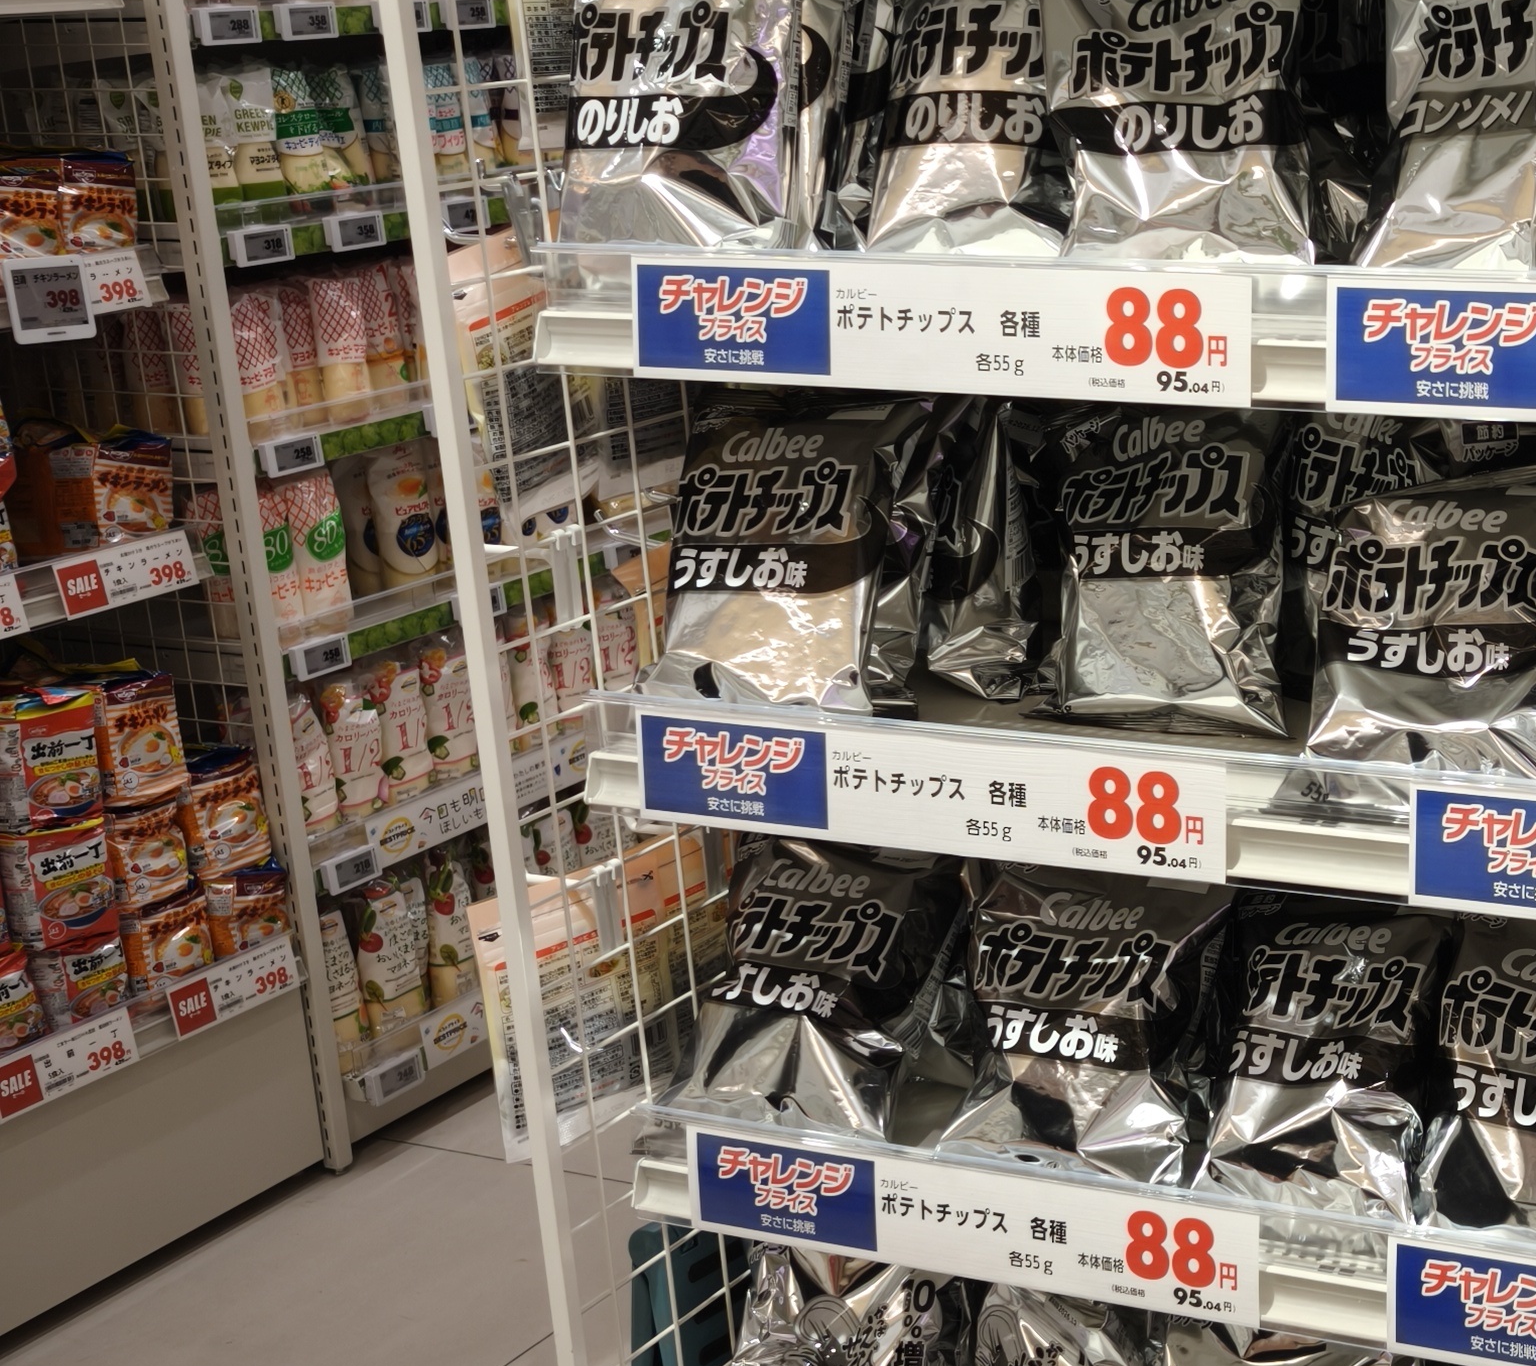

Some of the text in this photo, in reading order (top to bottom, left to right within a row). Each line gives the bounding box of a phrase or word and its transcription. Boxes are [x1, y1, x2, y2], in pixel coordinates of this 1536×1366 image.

[1070, 0, 1297, 98] ポテトチップス
[577, 96, 684, 146] のりしお
[1114, 95, 1263, 153] のりしお
[836, 303, 976, 335] ポテトチップス
[1409, 342, 1495, 376] プライス
[1415, 379, 1490, 401] 安さに挑戦
[721, 426, 824, 464] Calbee
[674, 458, 858, 537] ポテトチップス
[66, 572, 99, 597] SALE
[30, 733, 97, 761] 出前一丁
[833, 764, 966, 801] ポテトチップス
[974, 921, 1174, 1012] ポテトチップス
[178, 990, 209, 1018] SALE
[881, 1192, 1008, 1234] ポテトチップス
